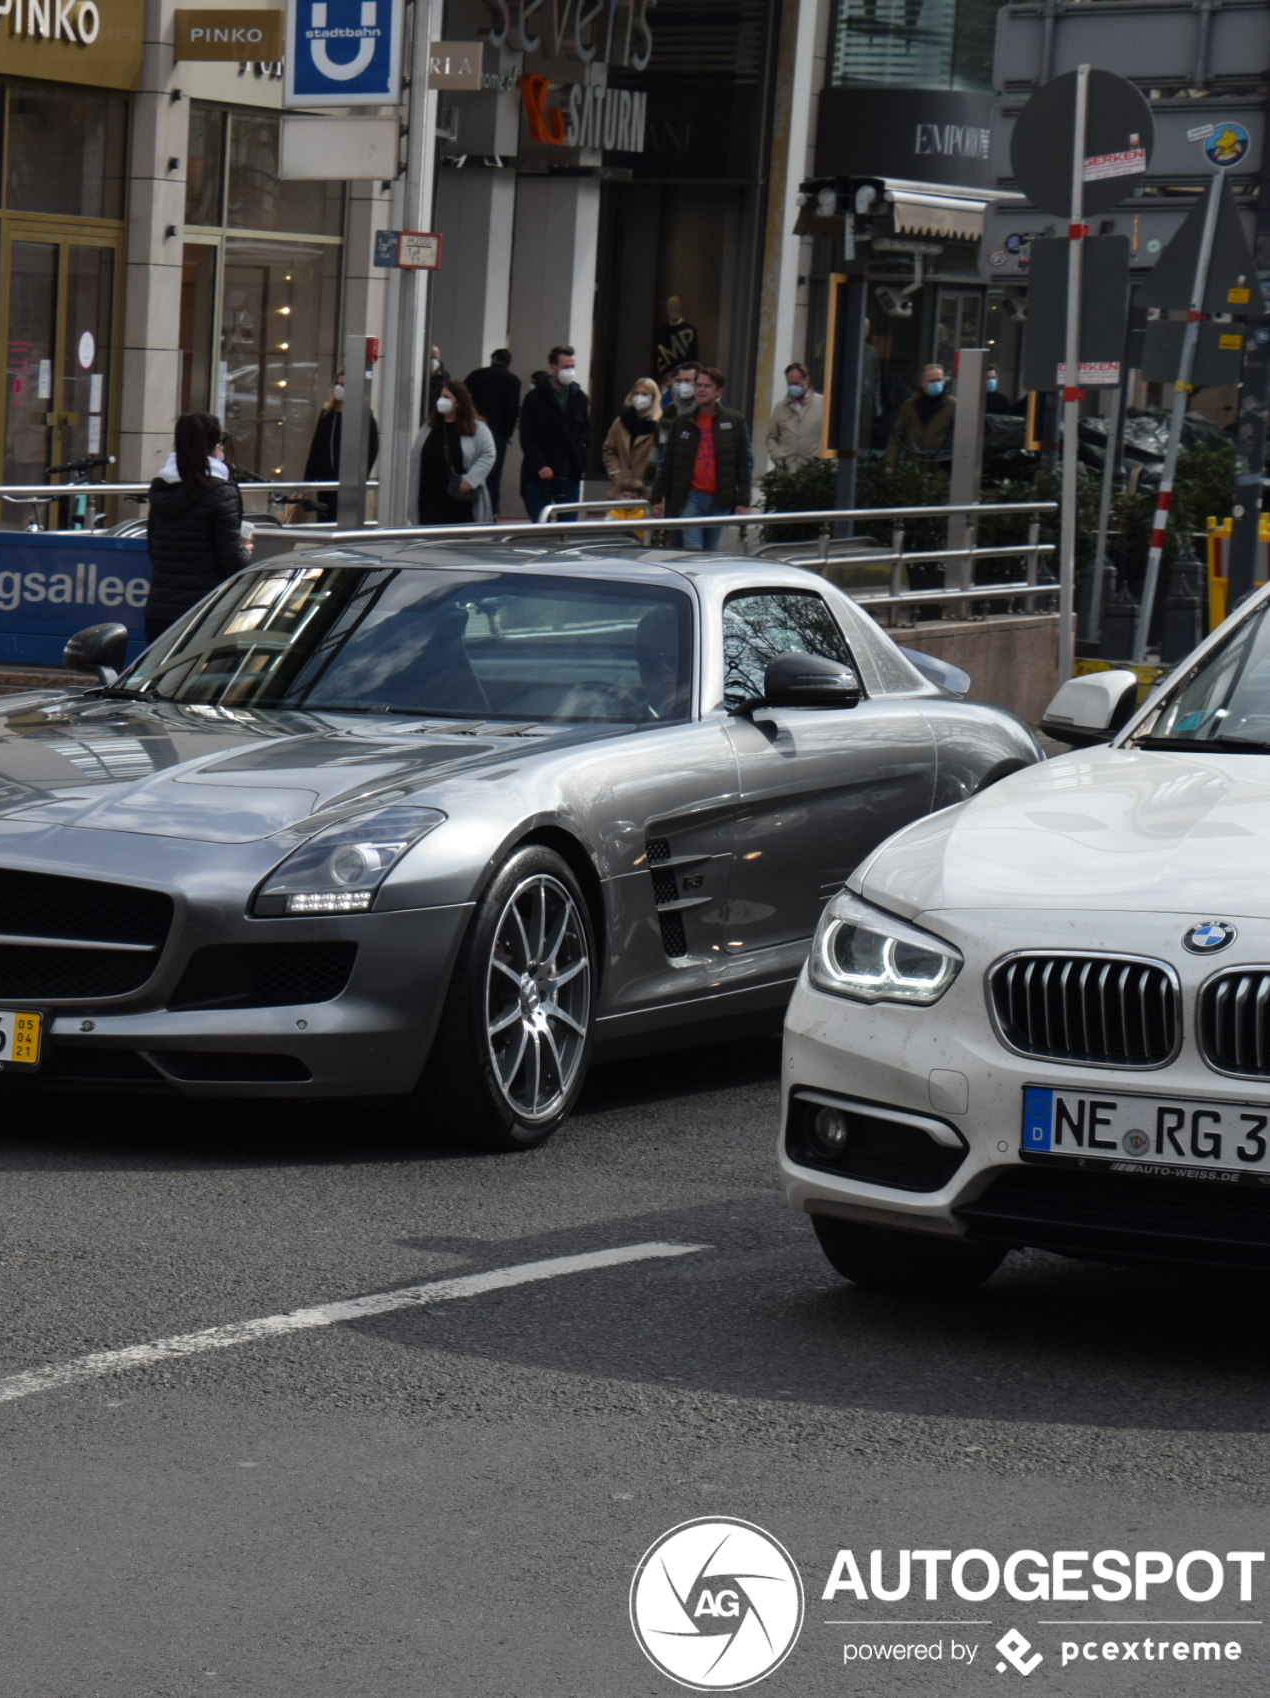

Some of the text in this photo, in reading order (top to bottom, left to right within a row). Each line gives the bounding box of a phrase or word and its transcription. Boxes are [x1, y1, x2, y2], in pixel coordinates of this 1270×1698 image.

[190, 28, 263, 42] PINKO
[305, 27, 381, 38] stadtbahn
[567, 83, 647, 152] SATURN
[1084, 149, 1145, 168] GERKEN
[1058, 362, 1119, 373] GRKEN
[18, 1019, 33, 1030] 05
[16, 1033, 33, 1043] 04
[15, 1046, 32, 1057] 21
[1032, 1127, 1043, 1141] D
[1054, 1097, 1269, 1163] NE RG 3
[1134, 1164, 1240, 1182] AUTO-WEISS.DE
